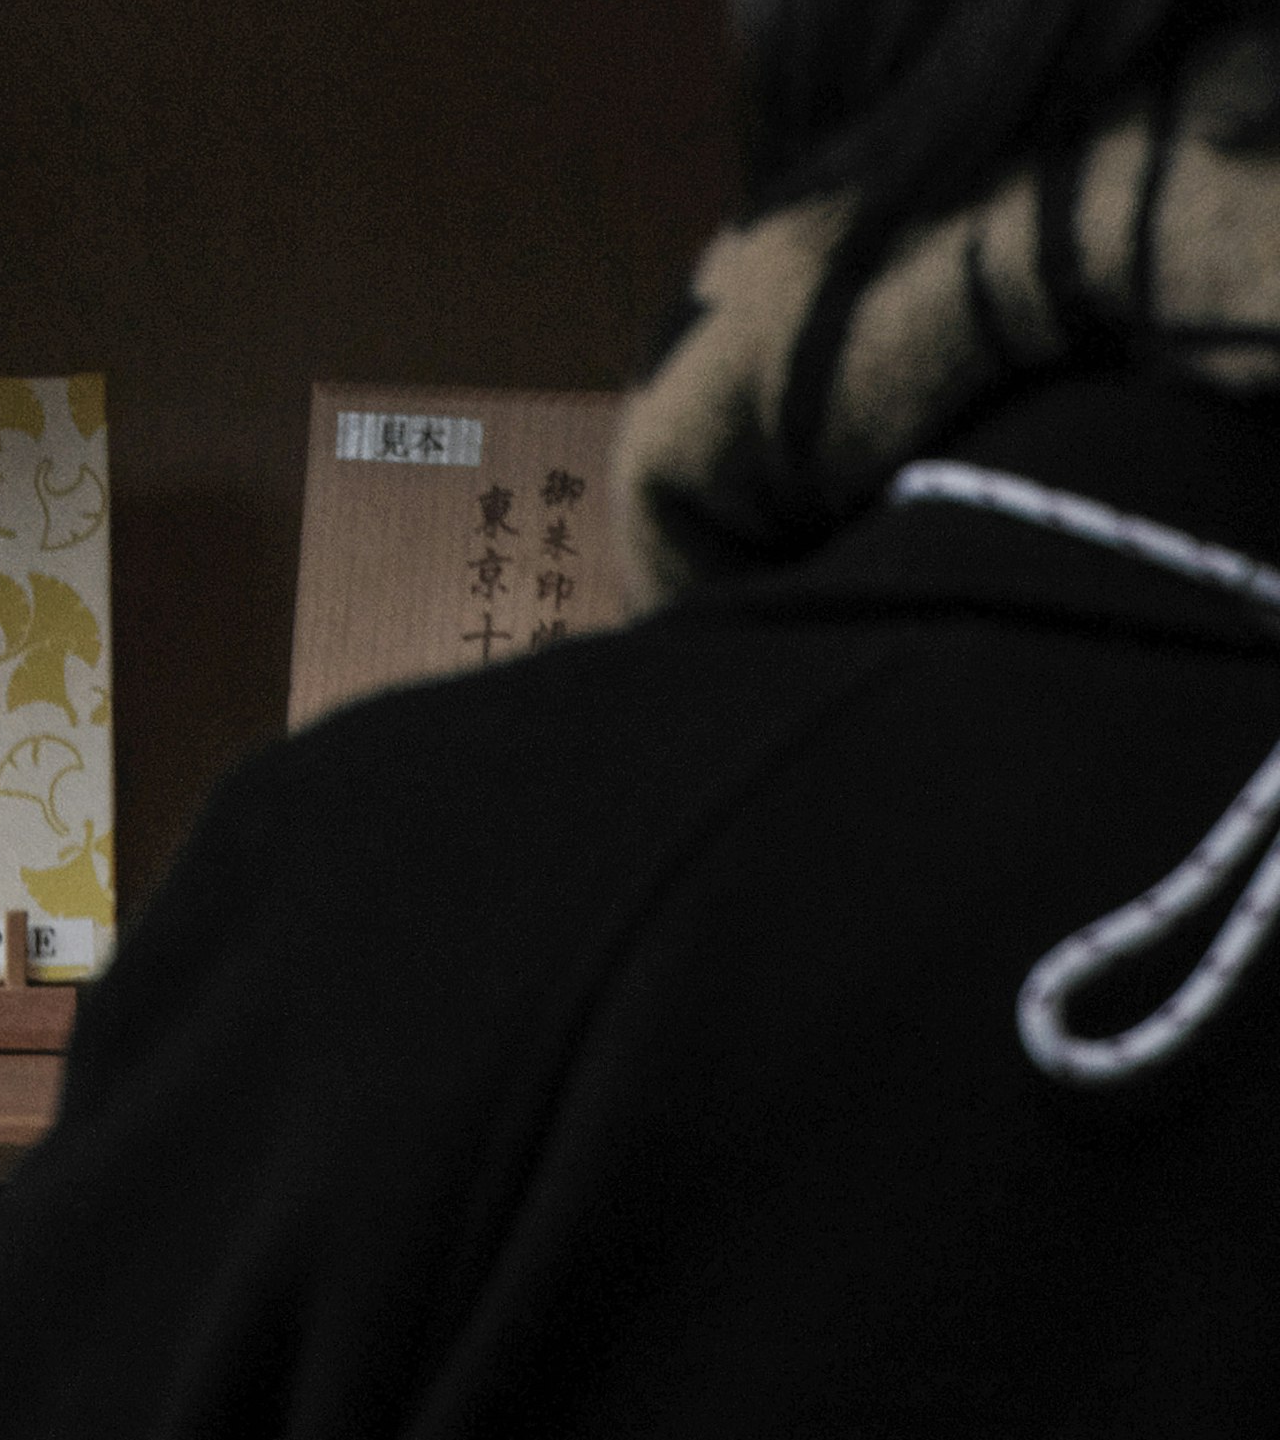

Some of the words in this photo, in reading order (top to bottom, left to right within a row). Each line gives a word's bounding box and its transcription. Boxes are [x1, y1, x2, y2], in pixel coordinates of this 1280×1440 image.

[379, 421, 446, 458] 見本
[462, 484, 521, 662] 東京十
